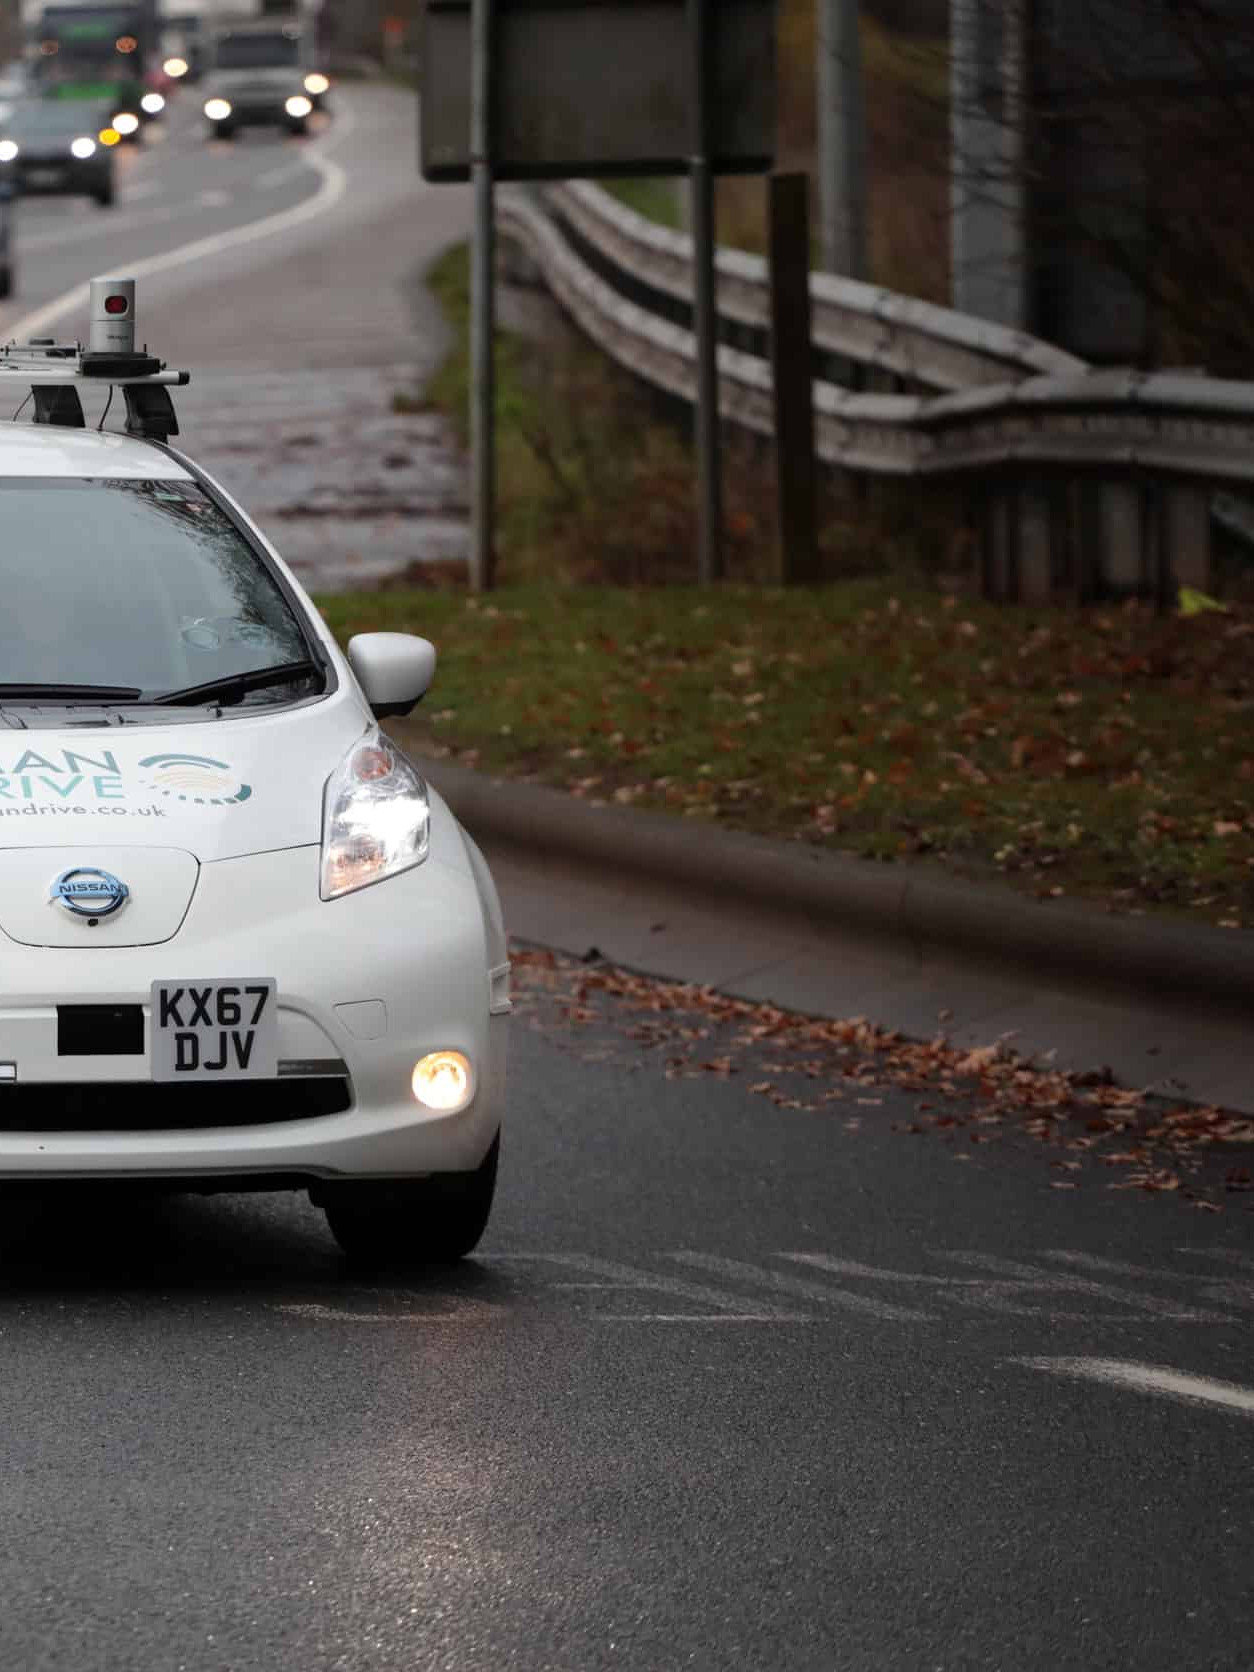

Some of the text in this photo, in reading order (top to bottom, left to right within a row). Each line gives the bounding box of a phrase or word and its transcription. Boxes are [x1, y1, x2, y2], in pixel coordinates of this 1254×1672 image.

[59, 883, 123, 894] NISSAN
[160, 986, 269, 1027] KX67
[175, 1030, 255, 1071] DJV
